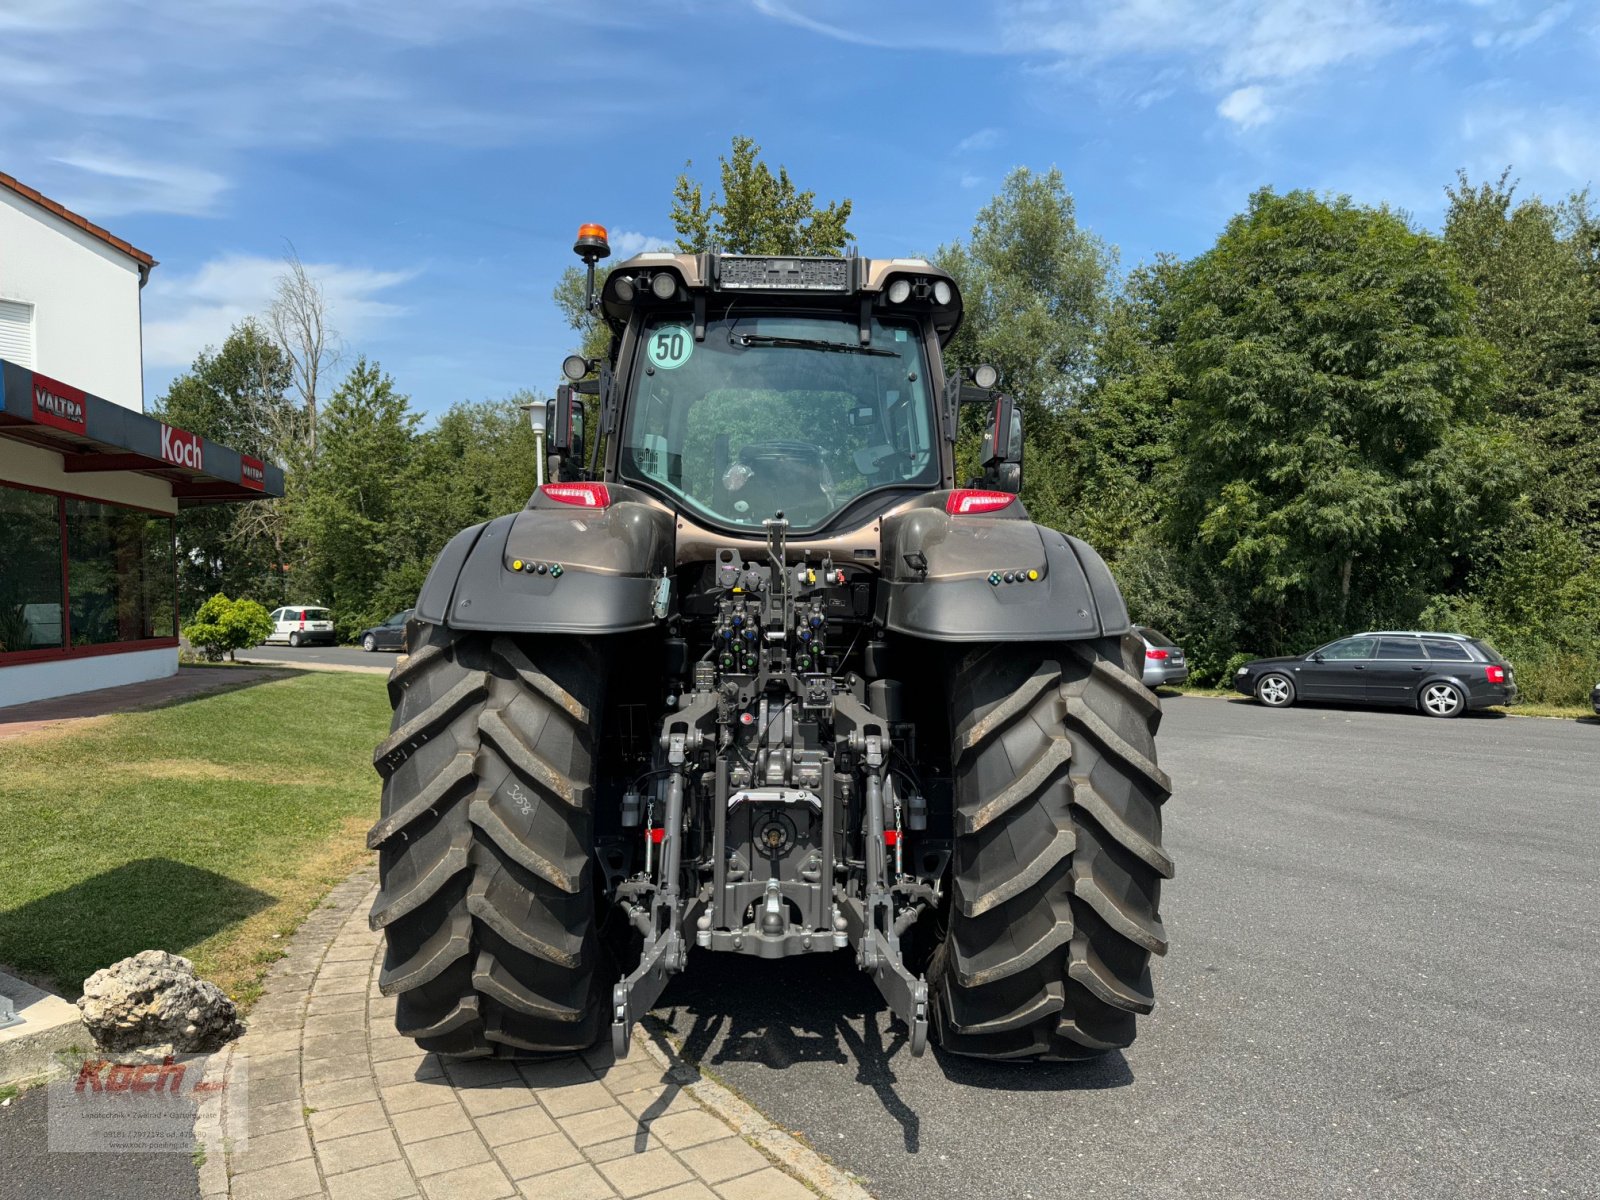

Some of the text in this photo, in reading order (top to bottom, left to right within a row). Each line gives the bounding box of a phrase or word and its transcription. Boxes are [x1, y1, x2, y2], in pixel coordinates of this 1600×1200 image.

[655, 333, 684, 360] 50
[34, 385, 84, 423] VALTRA
[161, 423, 202, 470] Koch
